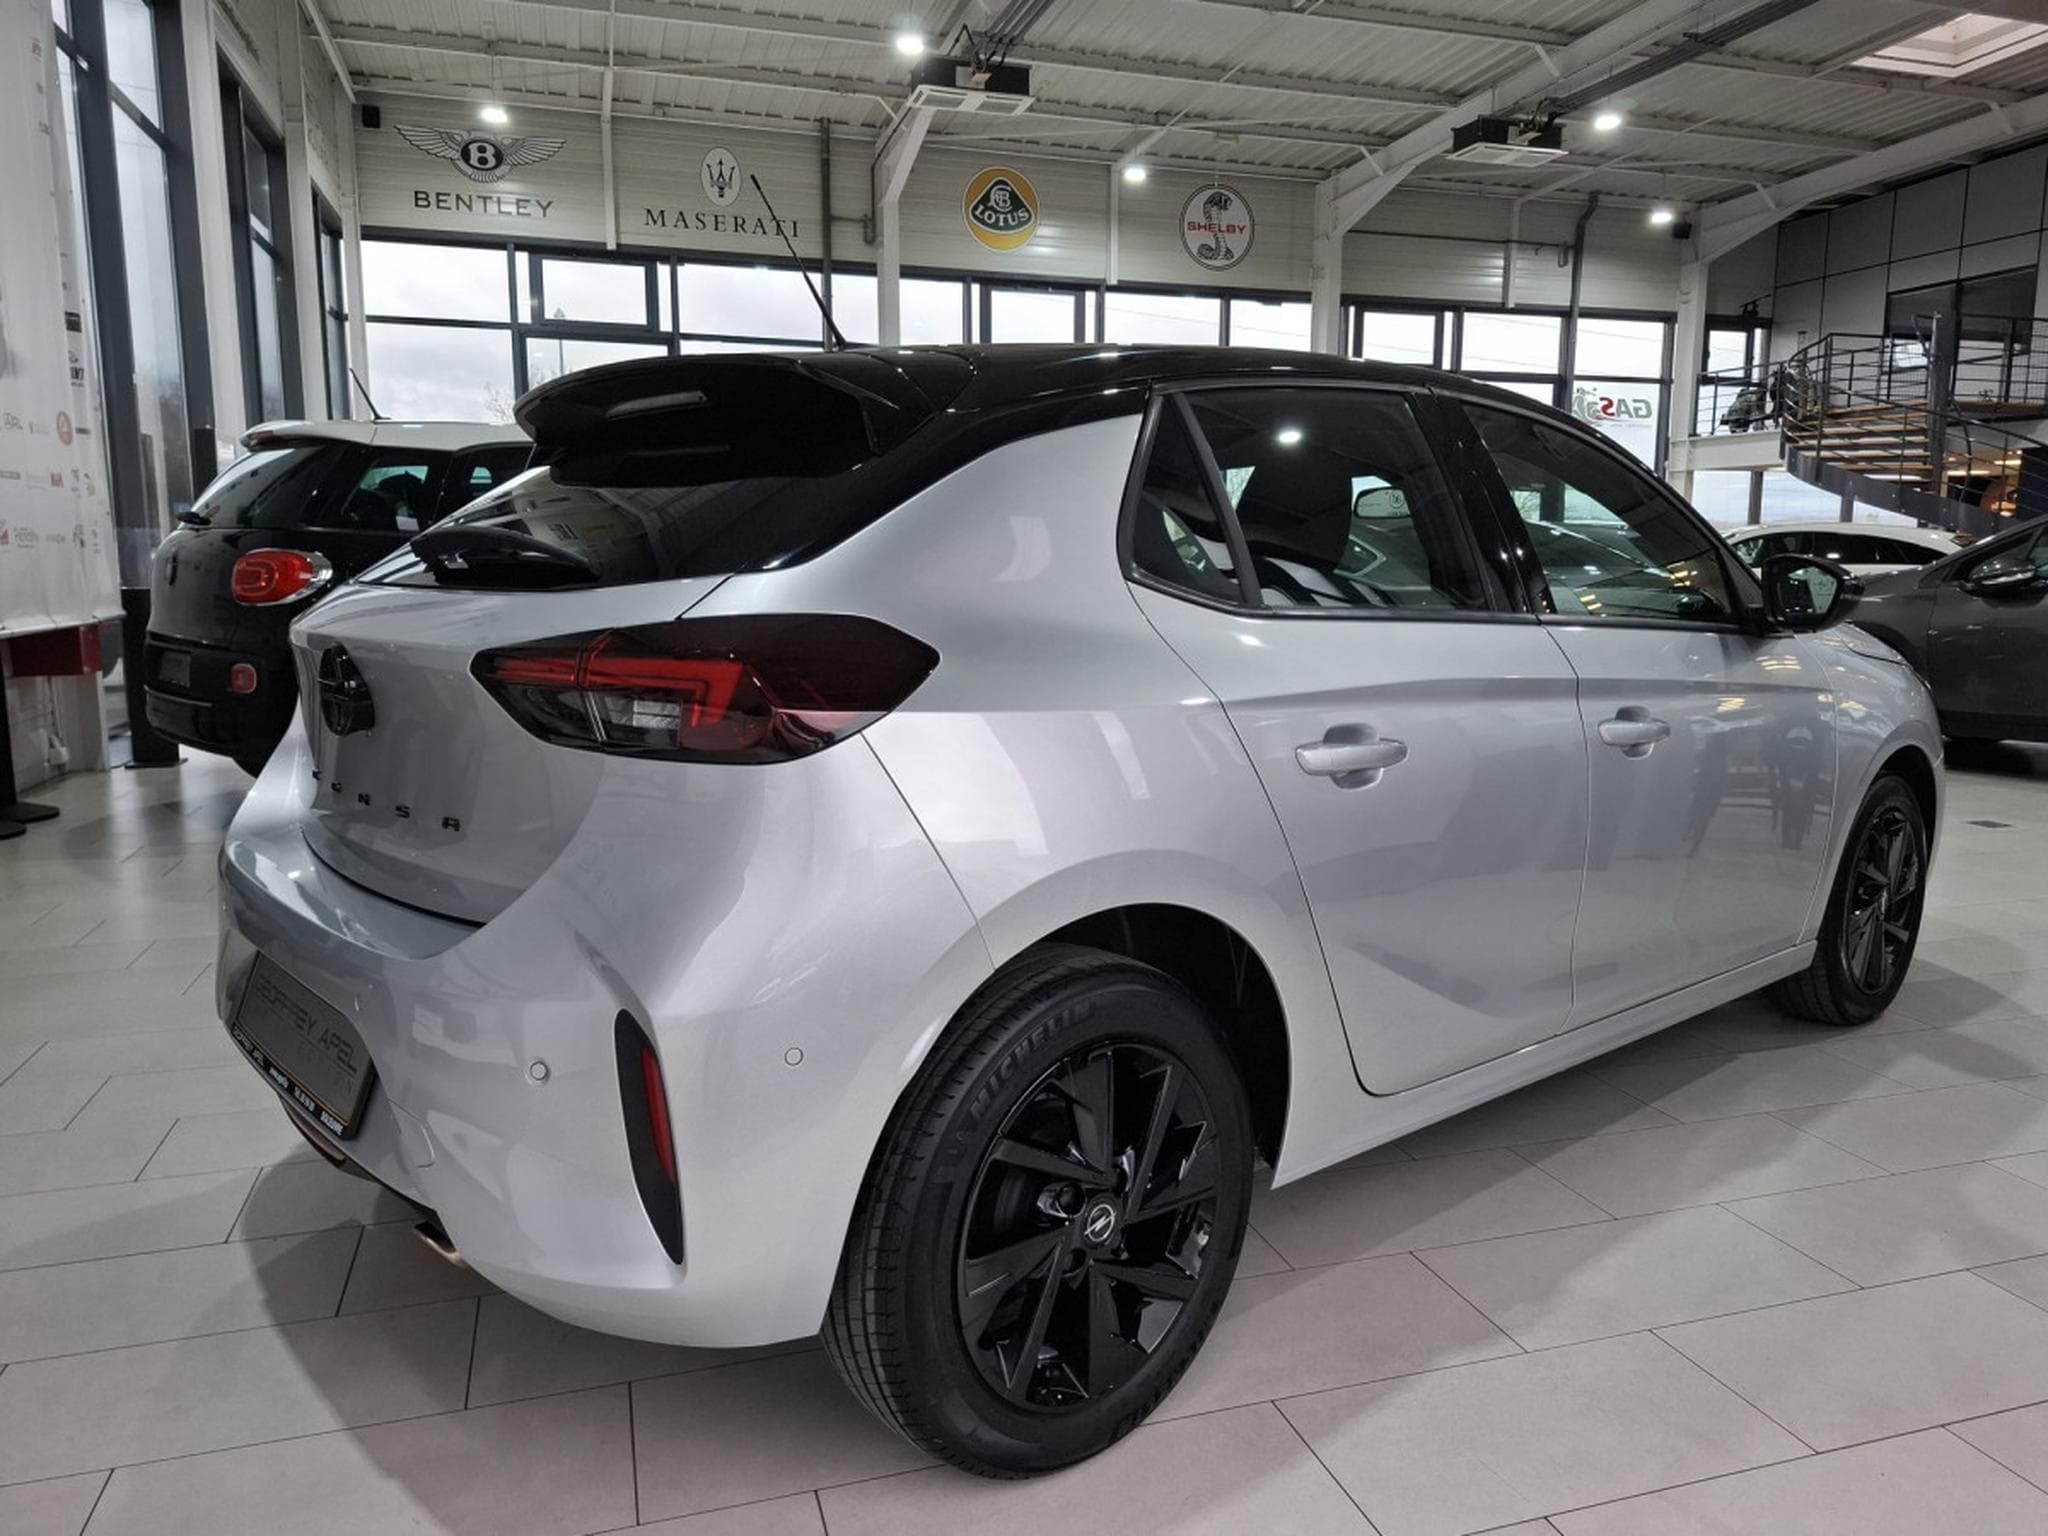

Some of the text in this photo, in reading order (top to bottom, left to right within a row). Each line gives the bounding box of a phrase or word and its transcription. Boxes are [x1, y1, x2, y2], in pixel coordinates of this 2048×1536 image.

[468, 142, 497, 169] B
[413, 190, 553, 218] BENTLEY
[975, 204, 1030, 226] LOTUS
[643, 207, 799, 238] MASERATI
[1187, 221, 1246, 234] SHELBY
